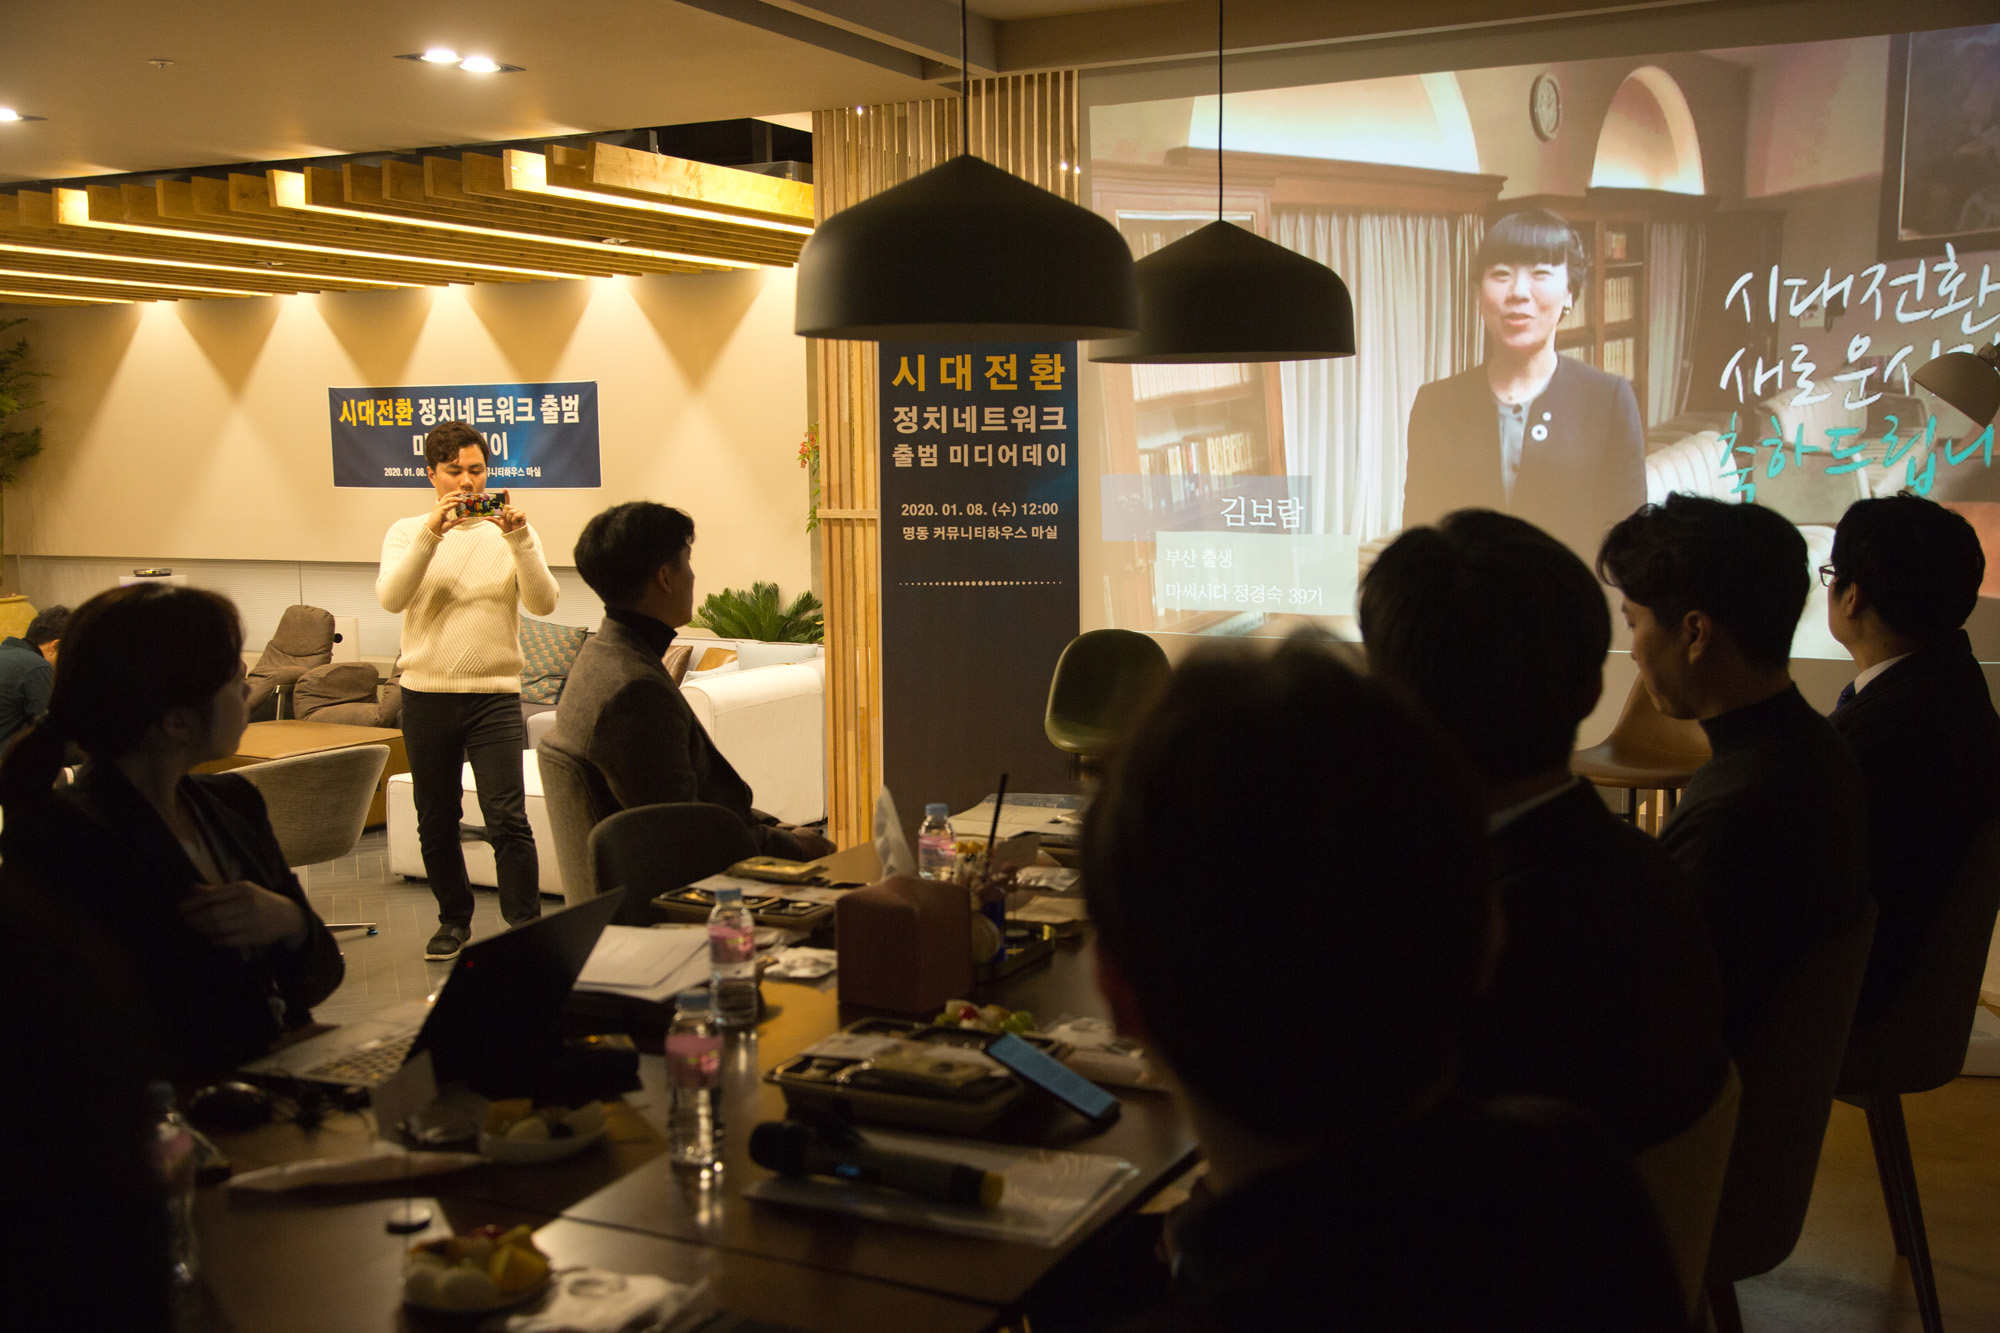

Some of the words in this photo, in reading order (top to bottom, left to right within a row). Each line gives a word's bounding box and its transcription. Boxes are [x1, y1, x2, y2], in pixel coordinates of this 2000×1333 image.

[1725, 242, 2000, 335] 시대전환
[891, 353, 1066, 392] 시대전환
[338, 398, 414, 427] 시대전환
[418, 396, 536, 426] 정치네트워크
[539, 394, 580, 425] 출범
[892, 404, 1067, 434] 정치네트워크
[892, 443, 939, 468] 출범
[949, 443, 1067, 467] 미디어데이
[384, 467, 402, 477] 2020.
[403, 467, 416, 477] 01.
[526, 466, 542, 478] 마실
[901, 503, 938, 517] 2020.
[941, 503, 963, 517] 01.
[966, 503, 988, 517] 08.
[992, 501, 1017, 518] (수)
[1021, 502, 1059, 516] 12:00
[1220, 495, 1304, 530] 김보람
[902, 526, 929, 541] 명동
[932, 526, 1028, 541] 커뮤니티하우스
[1031, 525, 1058, 541] 마실
[1165, 548, 1197, 569] 부산
[1202, 548, 1233, 569] 출생
[1232, 584, 1283, 605] 정경숙
[1288, 586, 1323, 607] 39기
